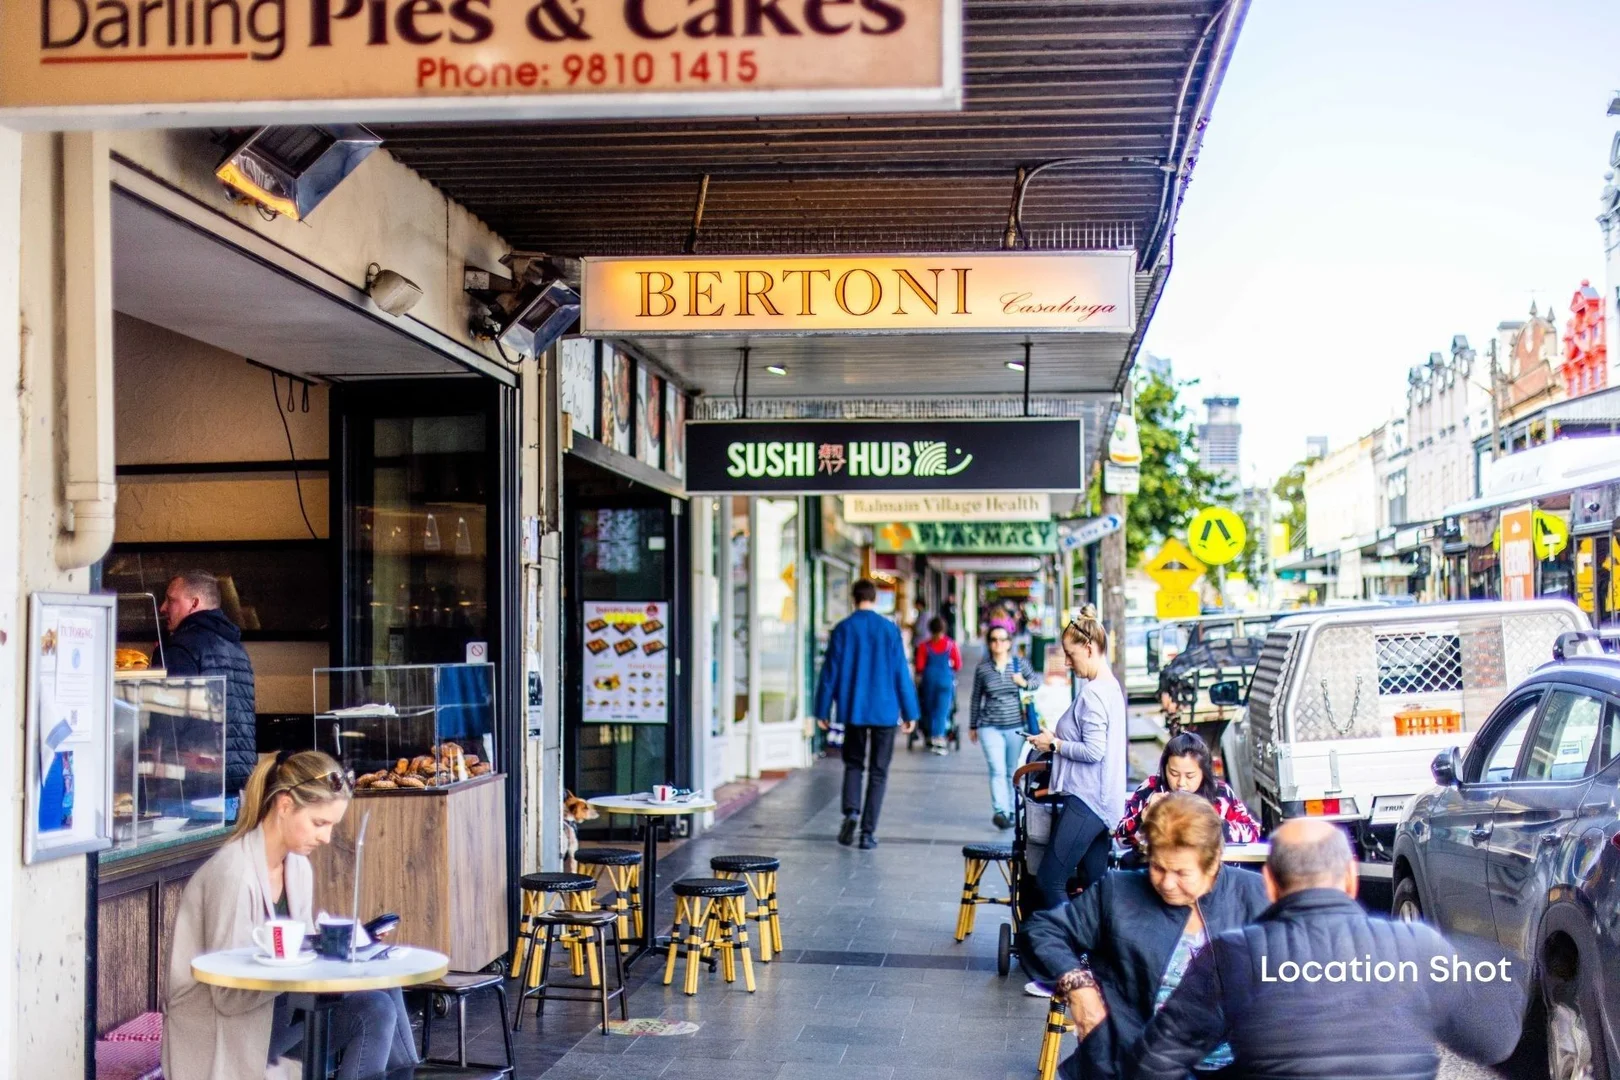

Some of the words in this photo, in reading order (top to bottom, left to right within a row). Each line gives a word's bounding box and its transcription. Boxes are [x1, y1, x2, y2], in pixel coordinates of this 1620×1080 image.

[40, 0, 286, 62] Darling
[307, 0, 495, 47] Pies
[525, 0, 593, 43] &
[623, 0, 907, 41] Cakes
[416, 57, 550, 88] Phone:
[562, 52, 654, 85] 9810
[671, 50, 758, 84] 1415
[634, 267, 973, 318] BERTONI
[998, 291, 1118, 323] Casalinga
[726, 441, 815, 478] SUSHI
[848, 441, 912, 477] HUB
[854, 497, 920, 513] Balmain
[924, 497, 982, 516] Village
[986, 496, 1040, 512] Health
[919, 529, 1051, 547] PHARMACY
